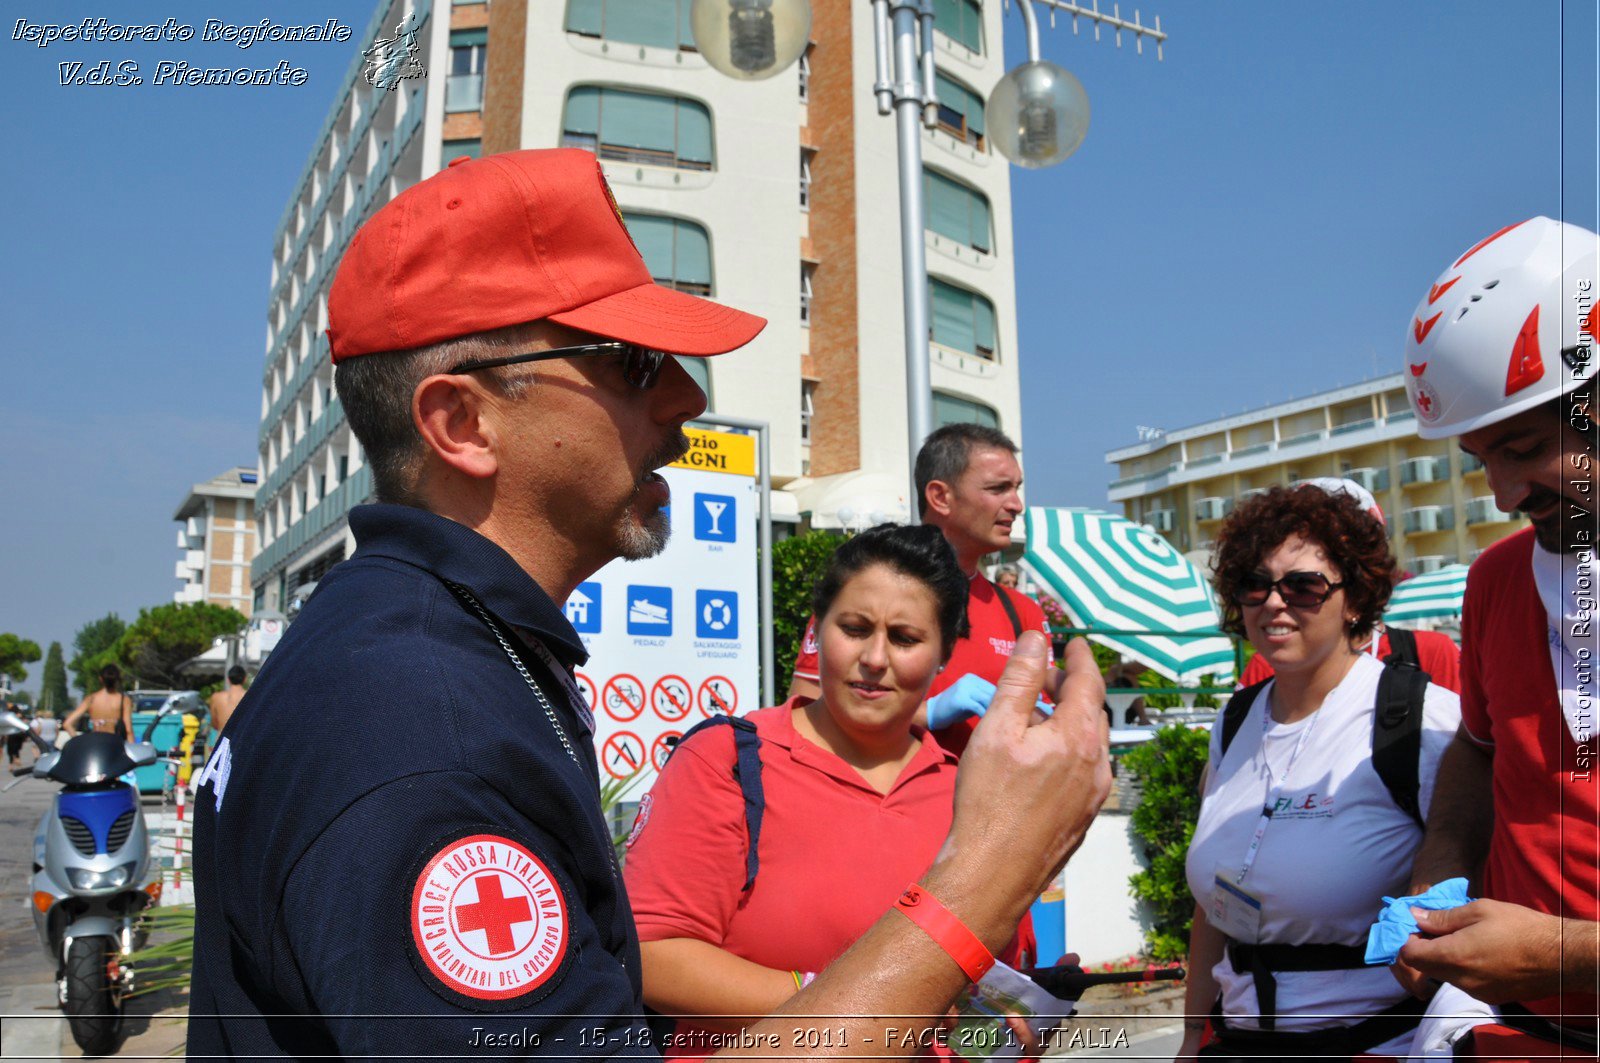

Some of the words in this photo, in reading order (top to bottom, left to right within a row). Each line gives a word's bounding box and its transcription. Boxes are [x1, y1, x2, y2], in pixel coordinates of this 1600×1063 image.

[691, 435, 718, 450] zio
[693, 641, 741, 650] SALVATAGGIO
[697, 651, 738, 659] LIFEGUARD
[423, 880, 450, 941] CROCE
[443, 845, 498, 878] ROSSA
[506, 850, 560, 919] ITALIANA
[432, 941, 491, 987] VOLONTARI
[499, 969, 521, 987] DEL
[523, 925, 559, 977] SOCCORSO
